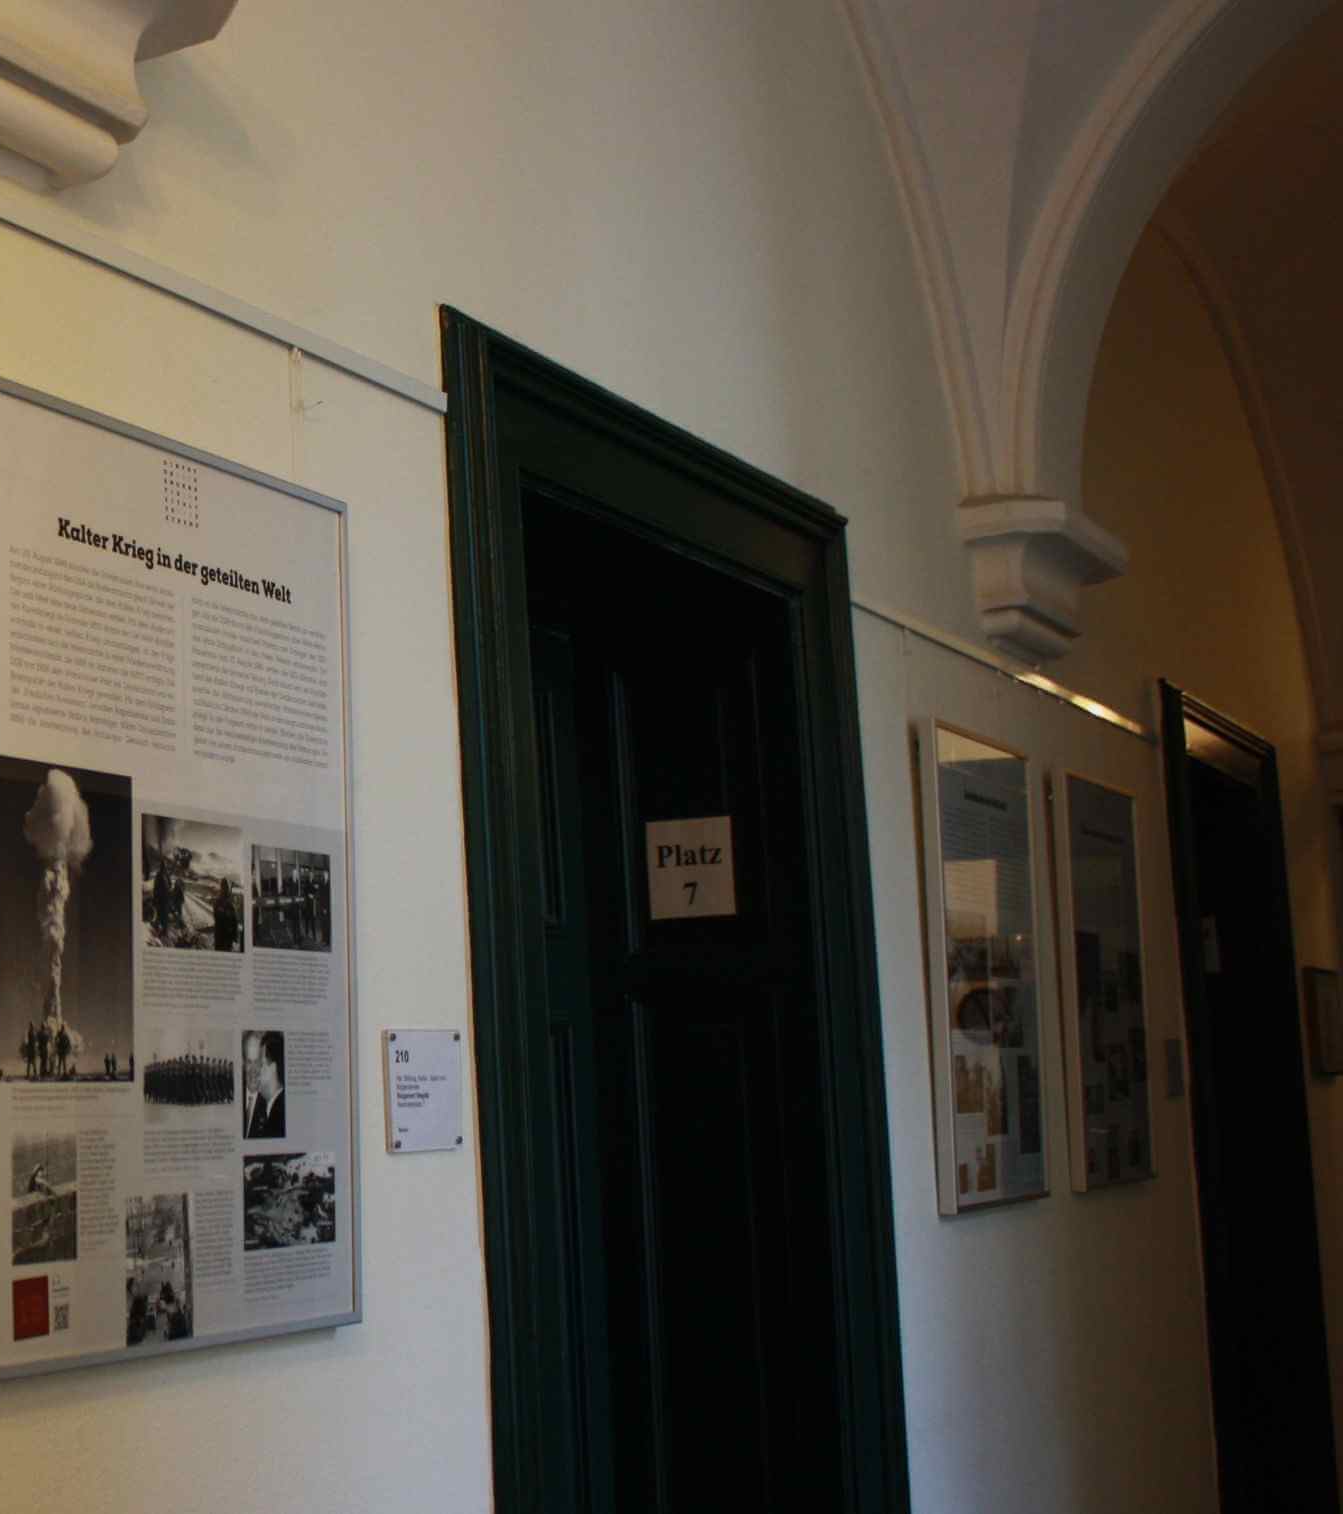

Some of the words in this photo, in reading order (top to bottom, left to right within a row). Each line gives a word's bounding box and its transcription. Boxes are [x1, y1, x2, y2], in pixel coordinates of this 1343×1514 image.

[58, 518, 109, 550] Kalter
[111, 534, 154, 569] Krieg
[157, 548, 172, 568] in
[174, 553, 199, 576] der
[201, 565, 260, 595] geteilten
[262, 579, 293, 604] Welt
[656, 844, 723, 869] Platz
[683, 881, 699, 905] 7
[395, 1049, 410, 1064] 210
